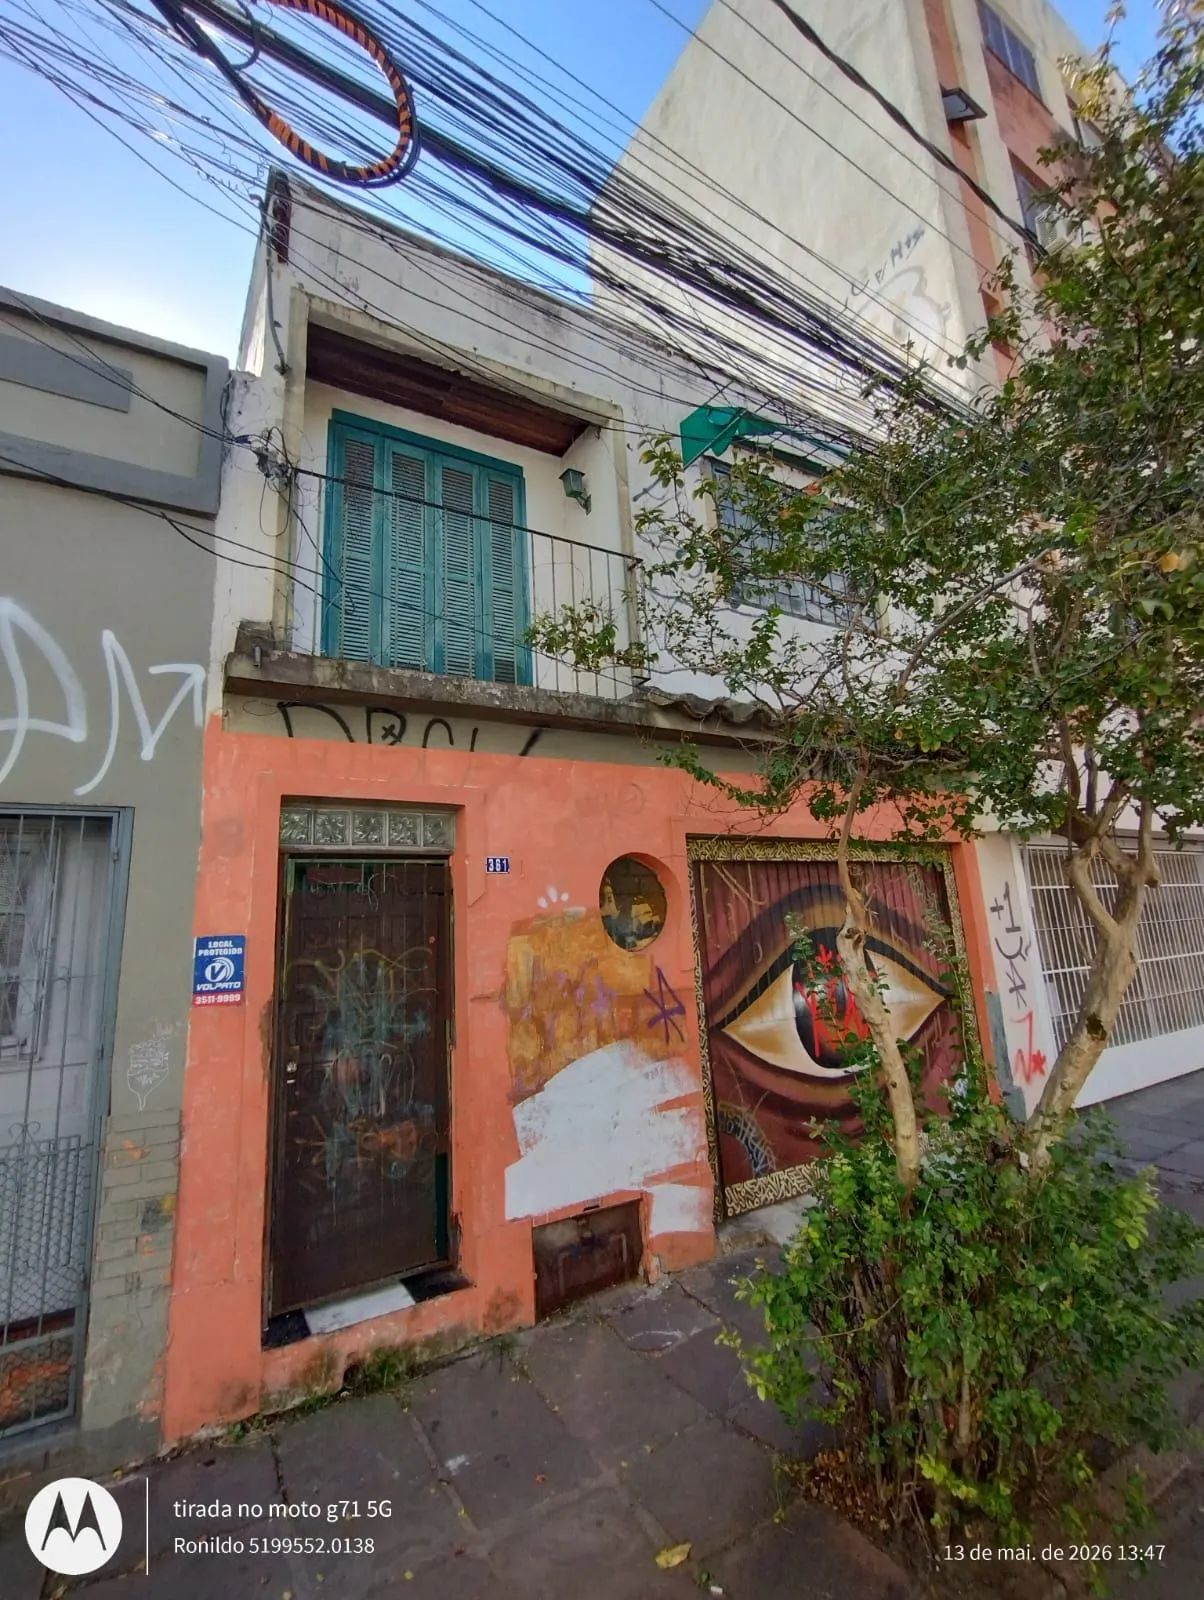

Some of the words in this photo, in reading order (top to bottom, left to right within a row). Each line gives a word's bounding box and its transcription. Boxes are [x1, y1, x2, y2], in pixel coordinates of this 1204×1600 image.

[208, 940, 233, 948] LOCAL
[198, 948, 242, 956] PROTEGIDO
[197, 981, 241, 991] VOLPATO
